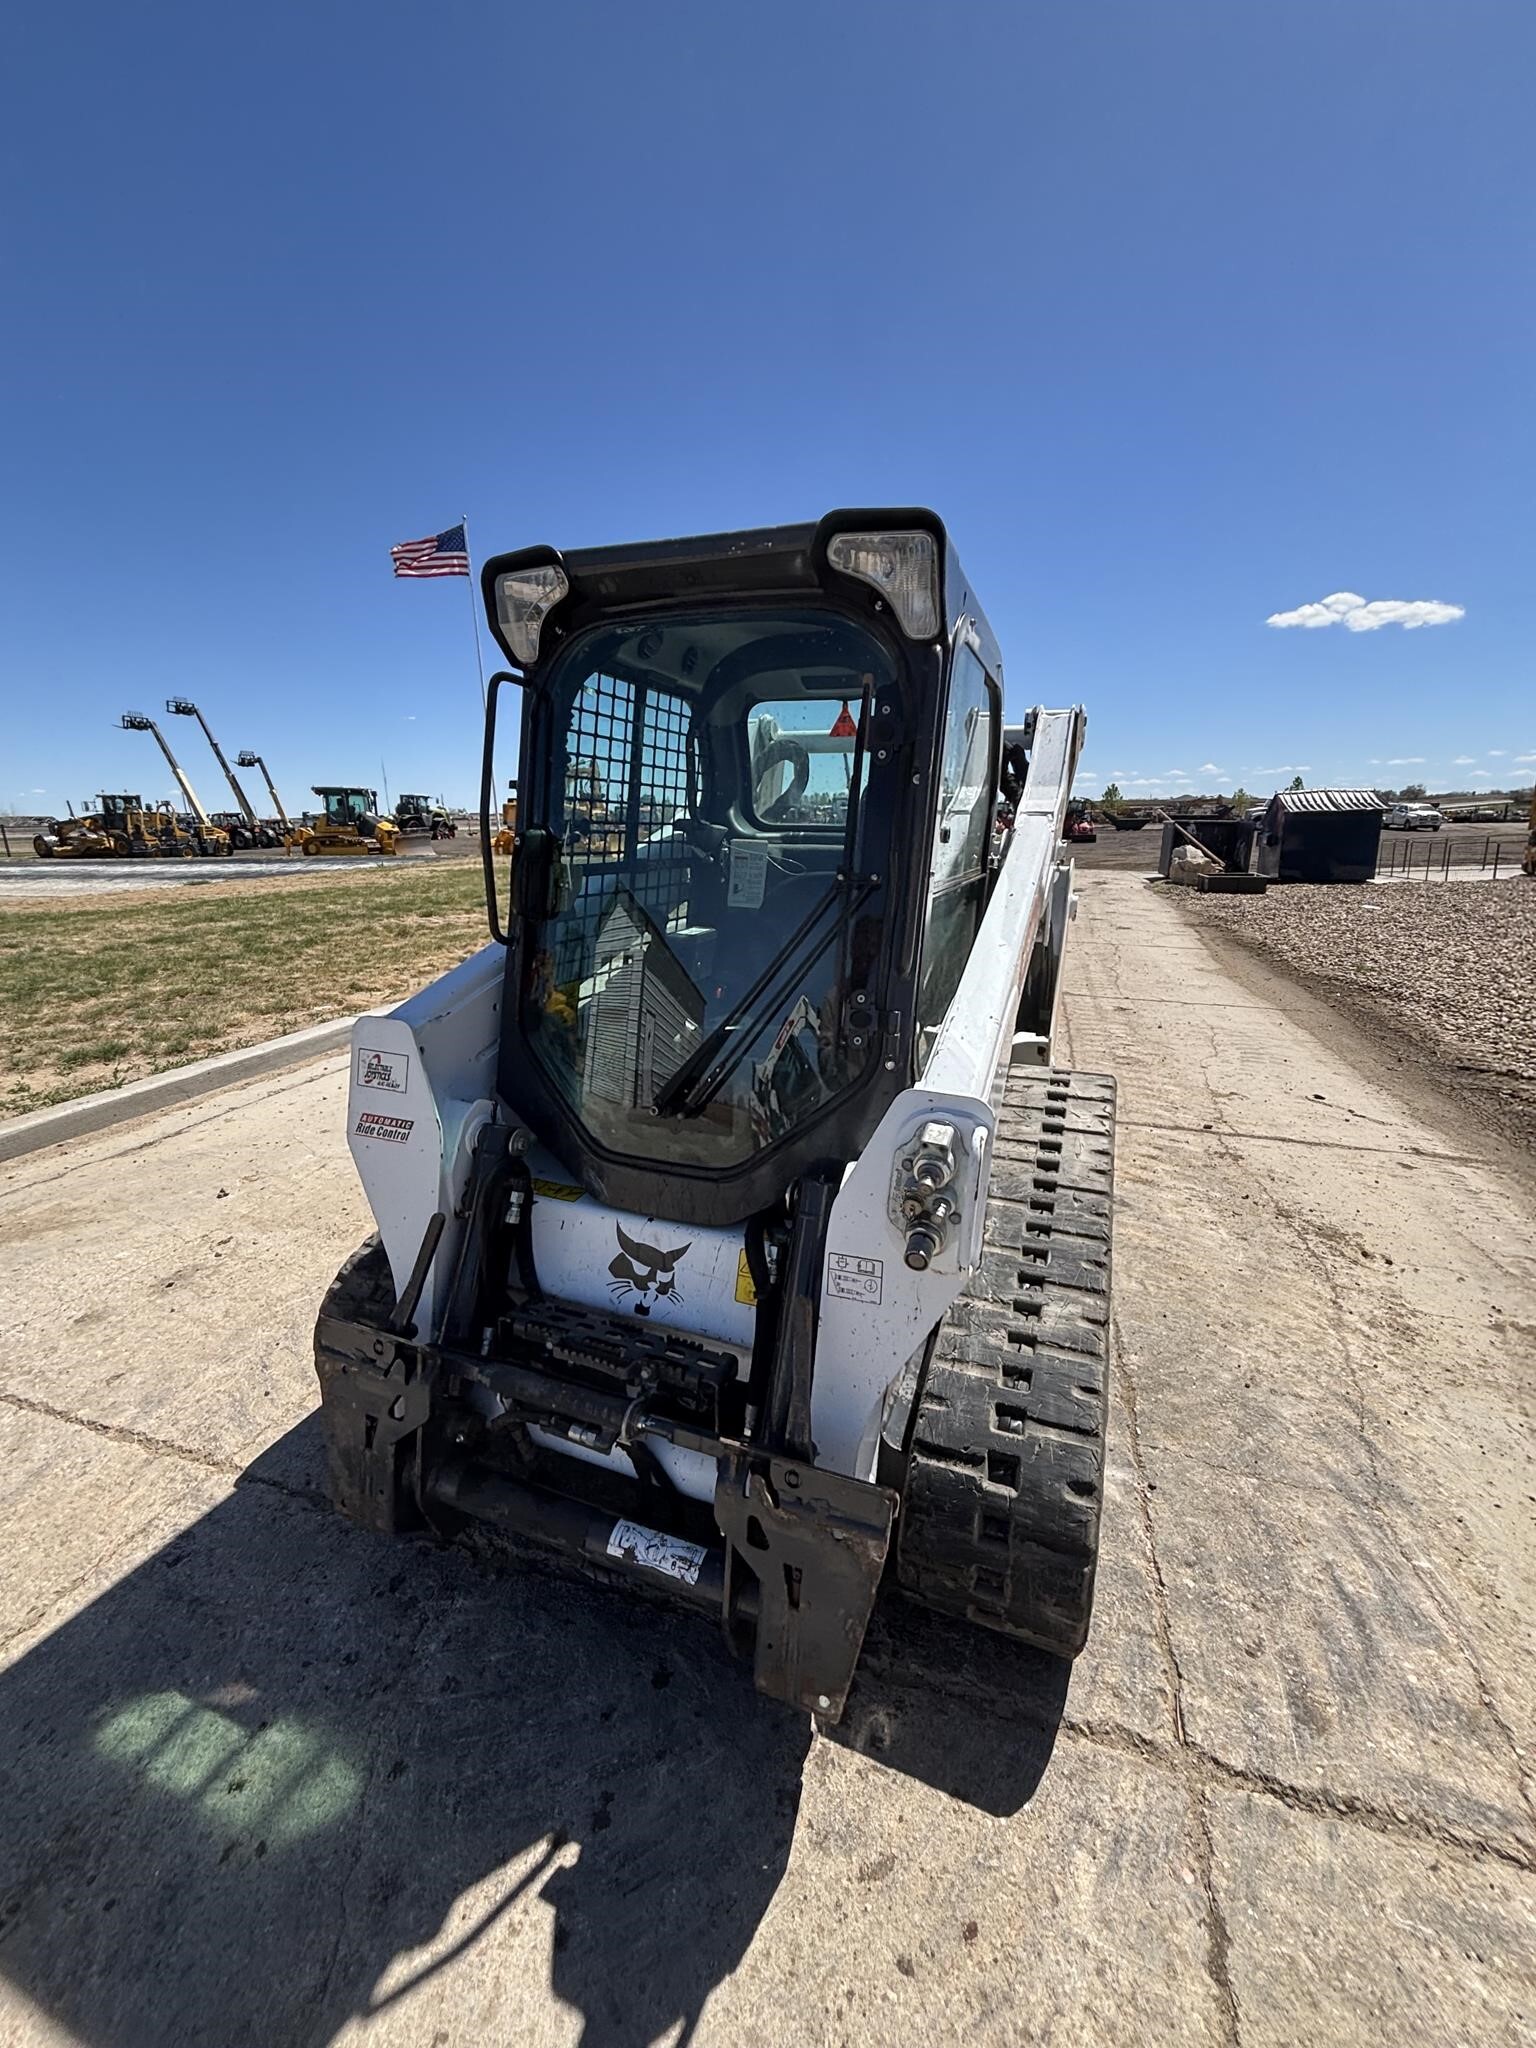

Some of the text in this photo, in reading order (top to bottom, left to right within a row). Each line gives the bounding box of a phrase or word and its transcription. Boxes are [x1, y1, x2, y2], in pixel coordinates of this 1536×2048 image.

[361, 1113, 411, 1128] AUTOMATIC
[355, 1122, 410, 1141] Ride Control
